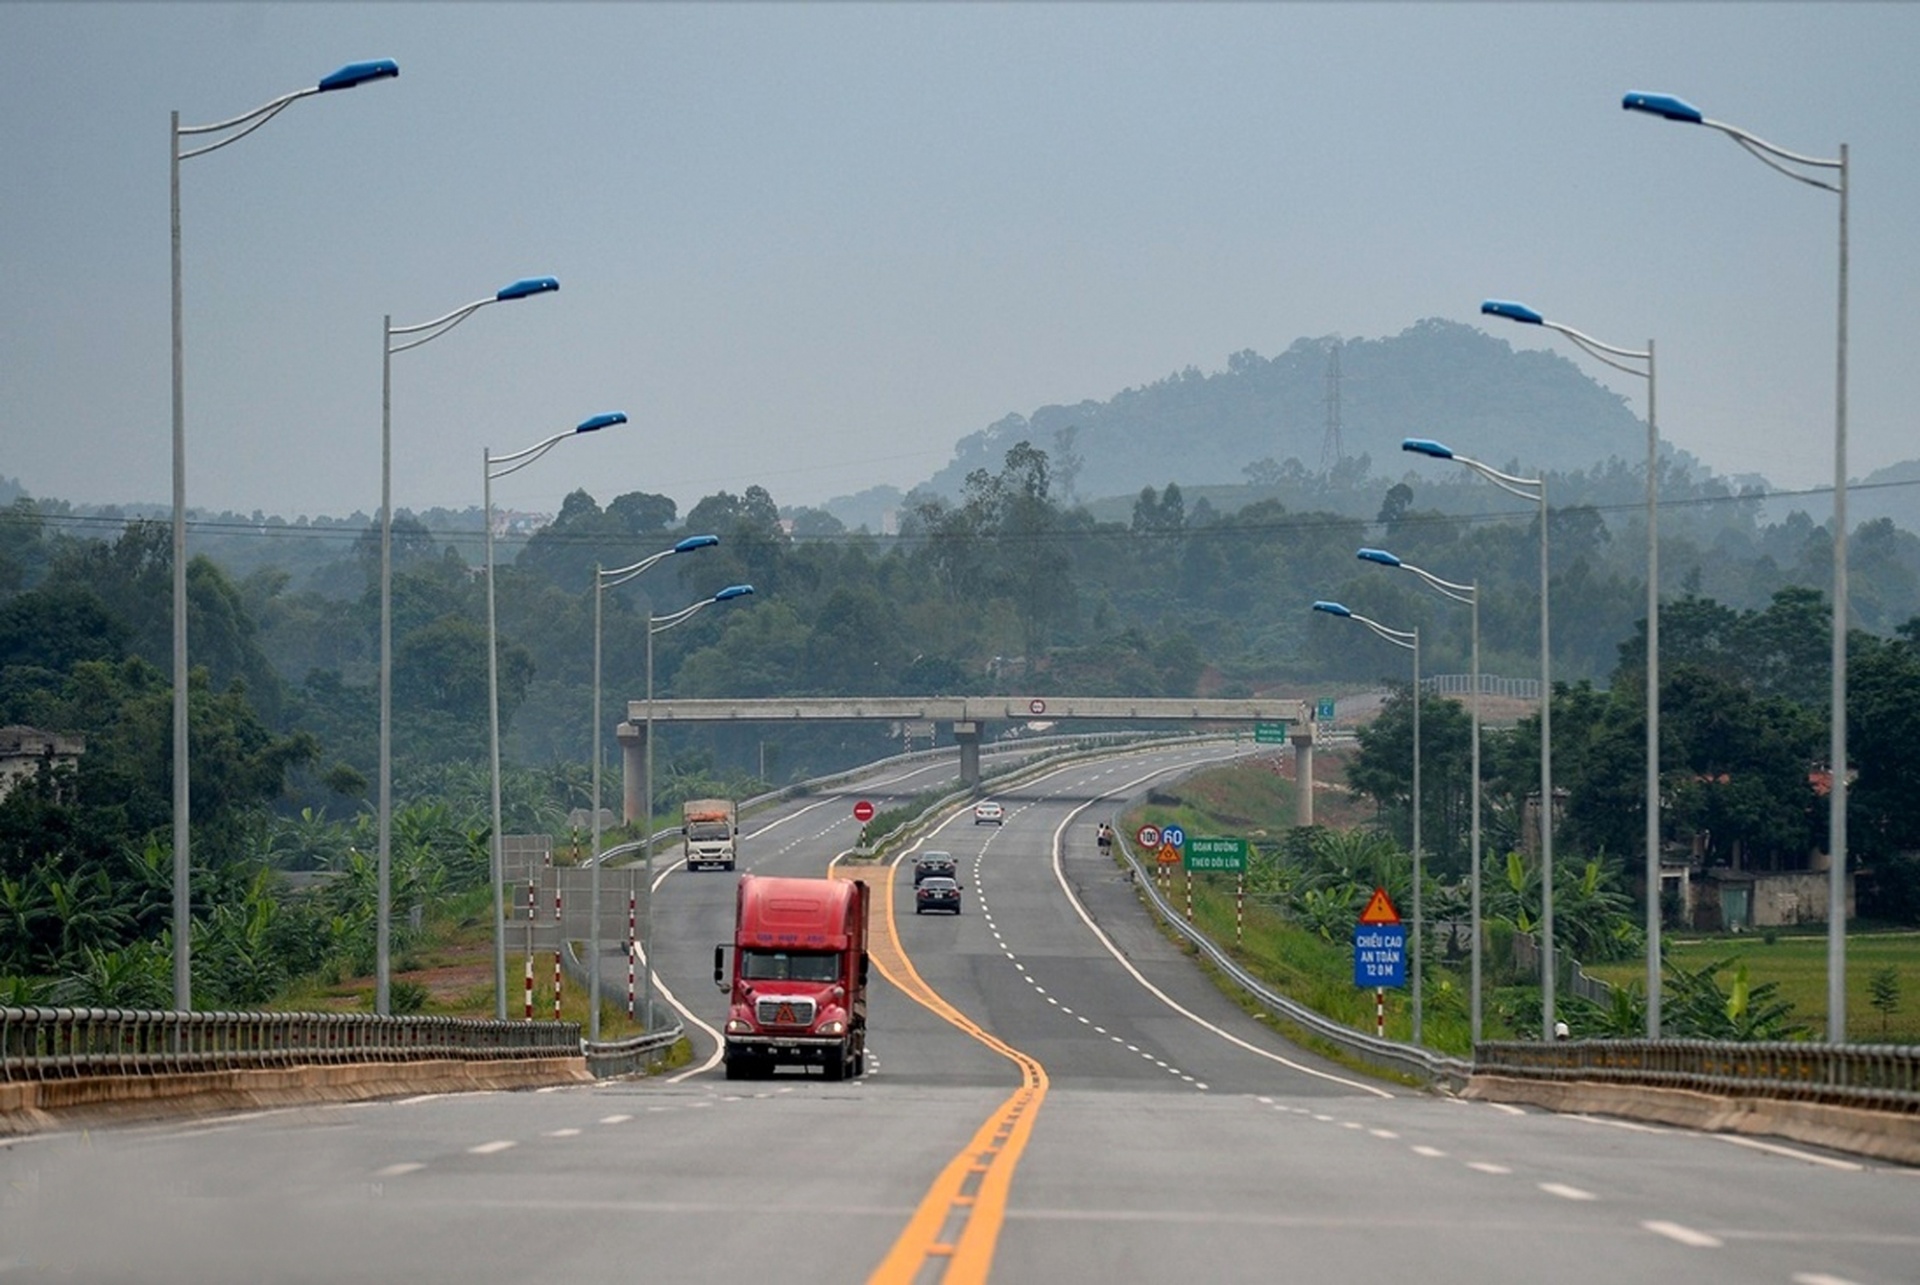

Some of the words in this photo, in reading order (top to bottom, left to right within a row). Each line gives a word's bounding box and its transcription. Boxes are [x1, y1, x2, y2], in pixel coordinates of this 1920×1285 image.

[1143, 831, 1156, 842] 100
[1164, 830, 1182, 845] 60
[1384, 935, 1403, 948] CAO
[1360, 951, 1374, 962] AN
